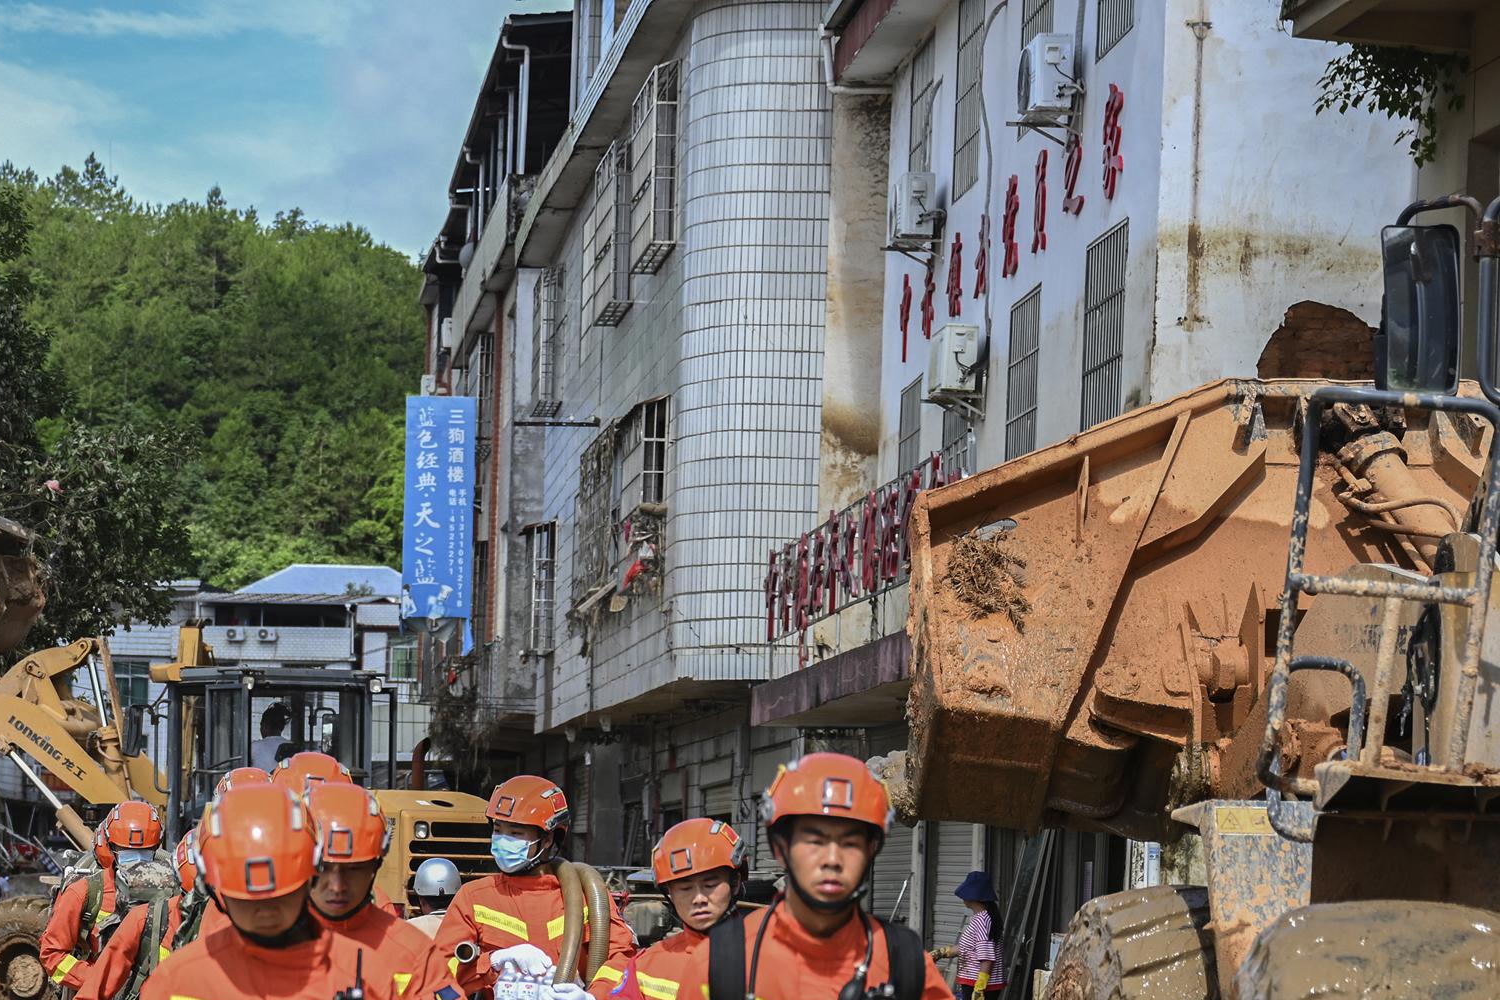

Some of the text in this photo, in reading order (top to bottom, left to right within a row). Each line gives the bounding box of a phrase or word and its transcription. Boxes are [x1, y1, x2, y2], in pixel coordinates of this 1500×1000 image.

[447, 408, 466, 483] 三狗酒楼
[61, 757, 87, 781] 龙工
